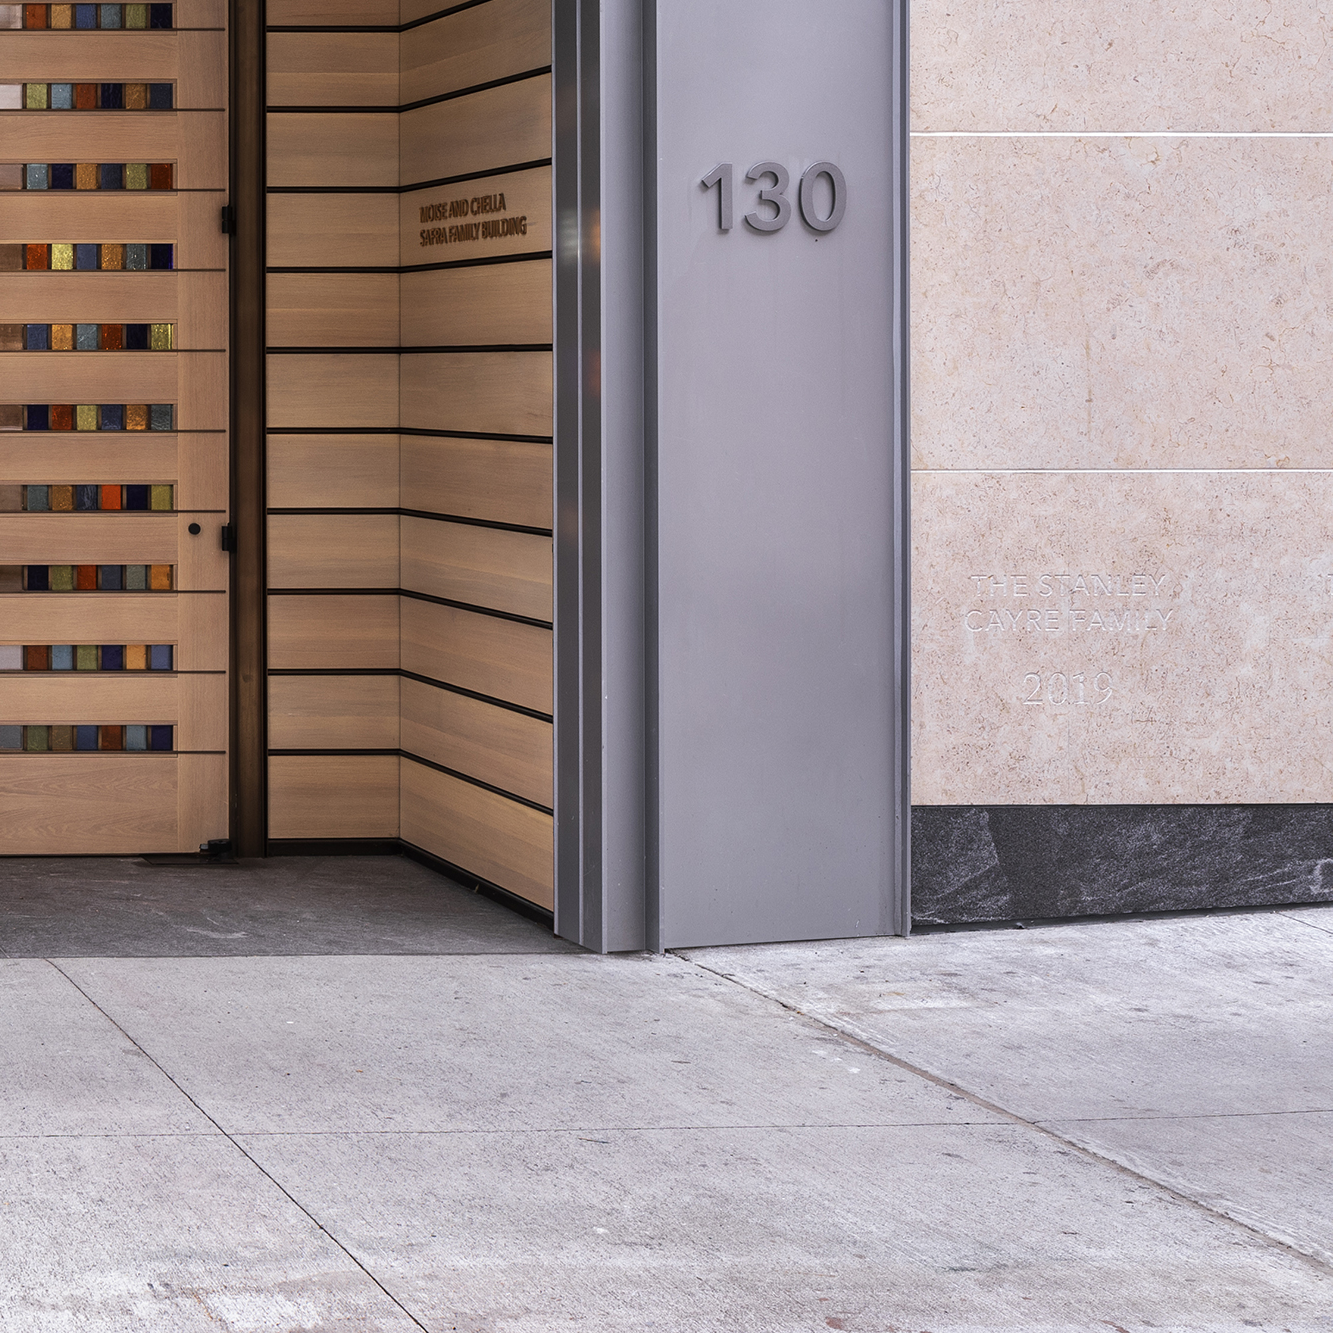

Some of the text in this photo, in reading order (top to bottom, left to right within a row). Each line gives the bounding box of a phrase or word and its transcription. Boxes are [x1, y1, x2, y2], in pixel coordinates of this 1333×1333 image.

[419, 192, 507, 223] MOISE AND CHELLA
[700, 161, 847, 233] 130
[420, 215, 528, 247] SAFRA FAMILY BUILDING
[971, 573, 1167, 597] THE STANLEY
[964, 609, 1174, 632] CAYRE FAMILY
[1022, 671, 1114, 706] 2019
